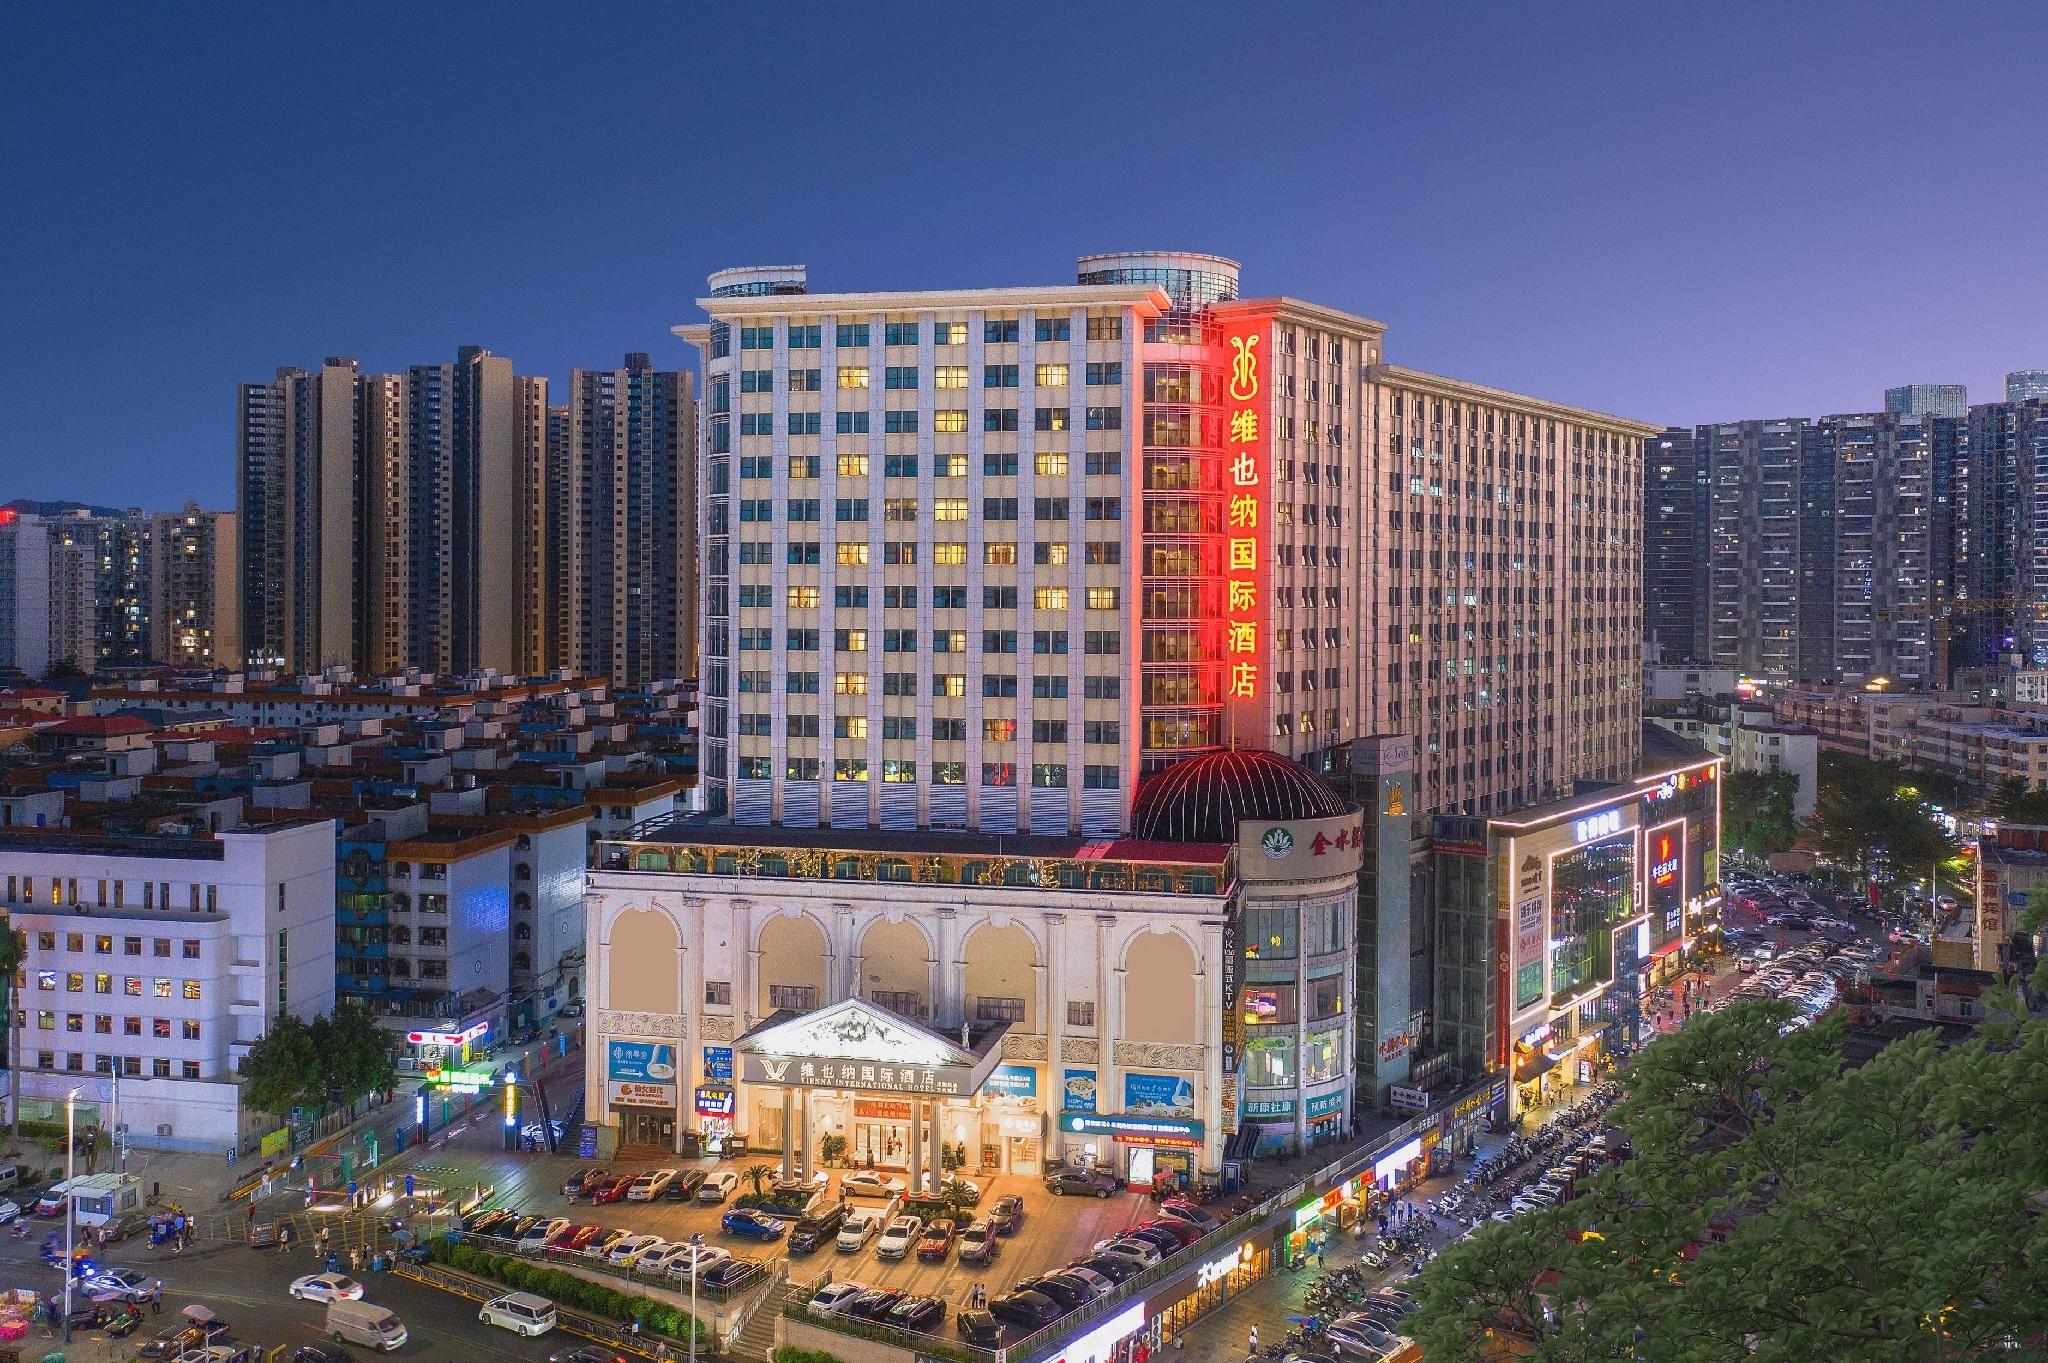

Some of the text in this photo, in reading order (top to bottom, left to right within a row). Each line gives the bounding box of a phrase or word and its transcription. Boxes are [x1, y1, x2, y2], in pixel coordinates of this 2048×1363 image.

[1228, 409, 1259, 698] 维也纳国际酒店
[800, 1061, 936, 1085] 维也纳国际酒店
[800, 1077, 936, 1092] VIENNA INTERNATIONAL HOTEL
[1311, 1096, 1343, 1112] 预防接种
[228, 1149, 234, 1161] P
